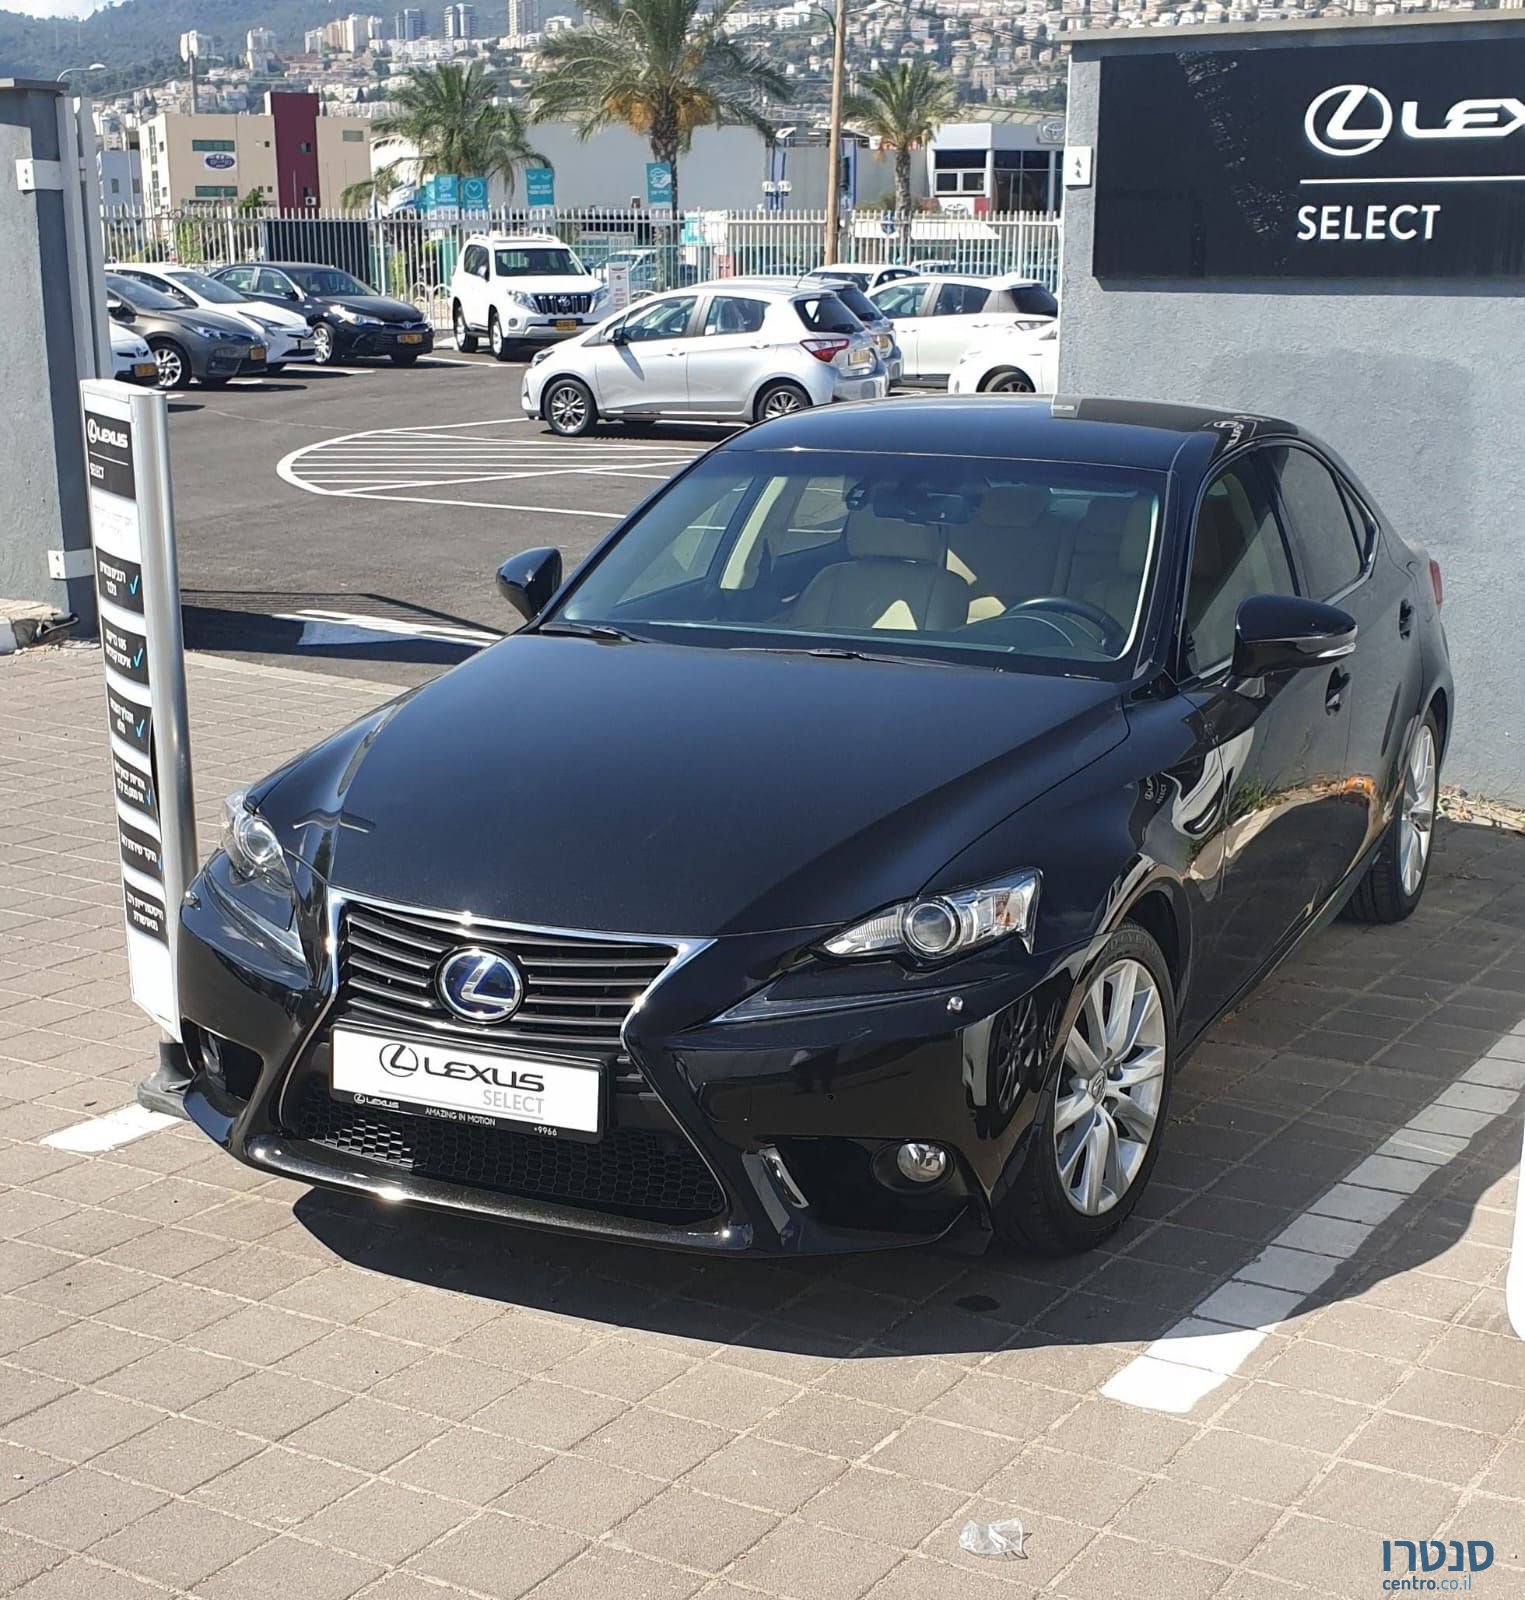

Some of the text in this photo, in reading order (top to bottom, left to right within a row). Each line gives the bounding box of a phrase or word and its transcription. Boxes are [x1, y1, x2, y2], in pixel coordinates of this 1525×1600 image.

[1297, 204, 1441, 241] SELECT
[97, 428, 128, 449] LEXUS
[424, 1057, 544, 1092] LEXUS
[366, 1097, 400, 1109] LEXUS
[482, 1089, 544, 1114] SELECT
[425, 1107, 496, 1127] AMAZING IN MOTION
